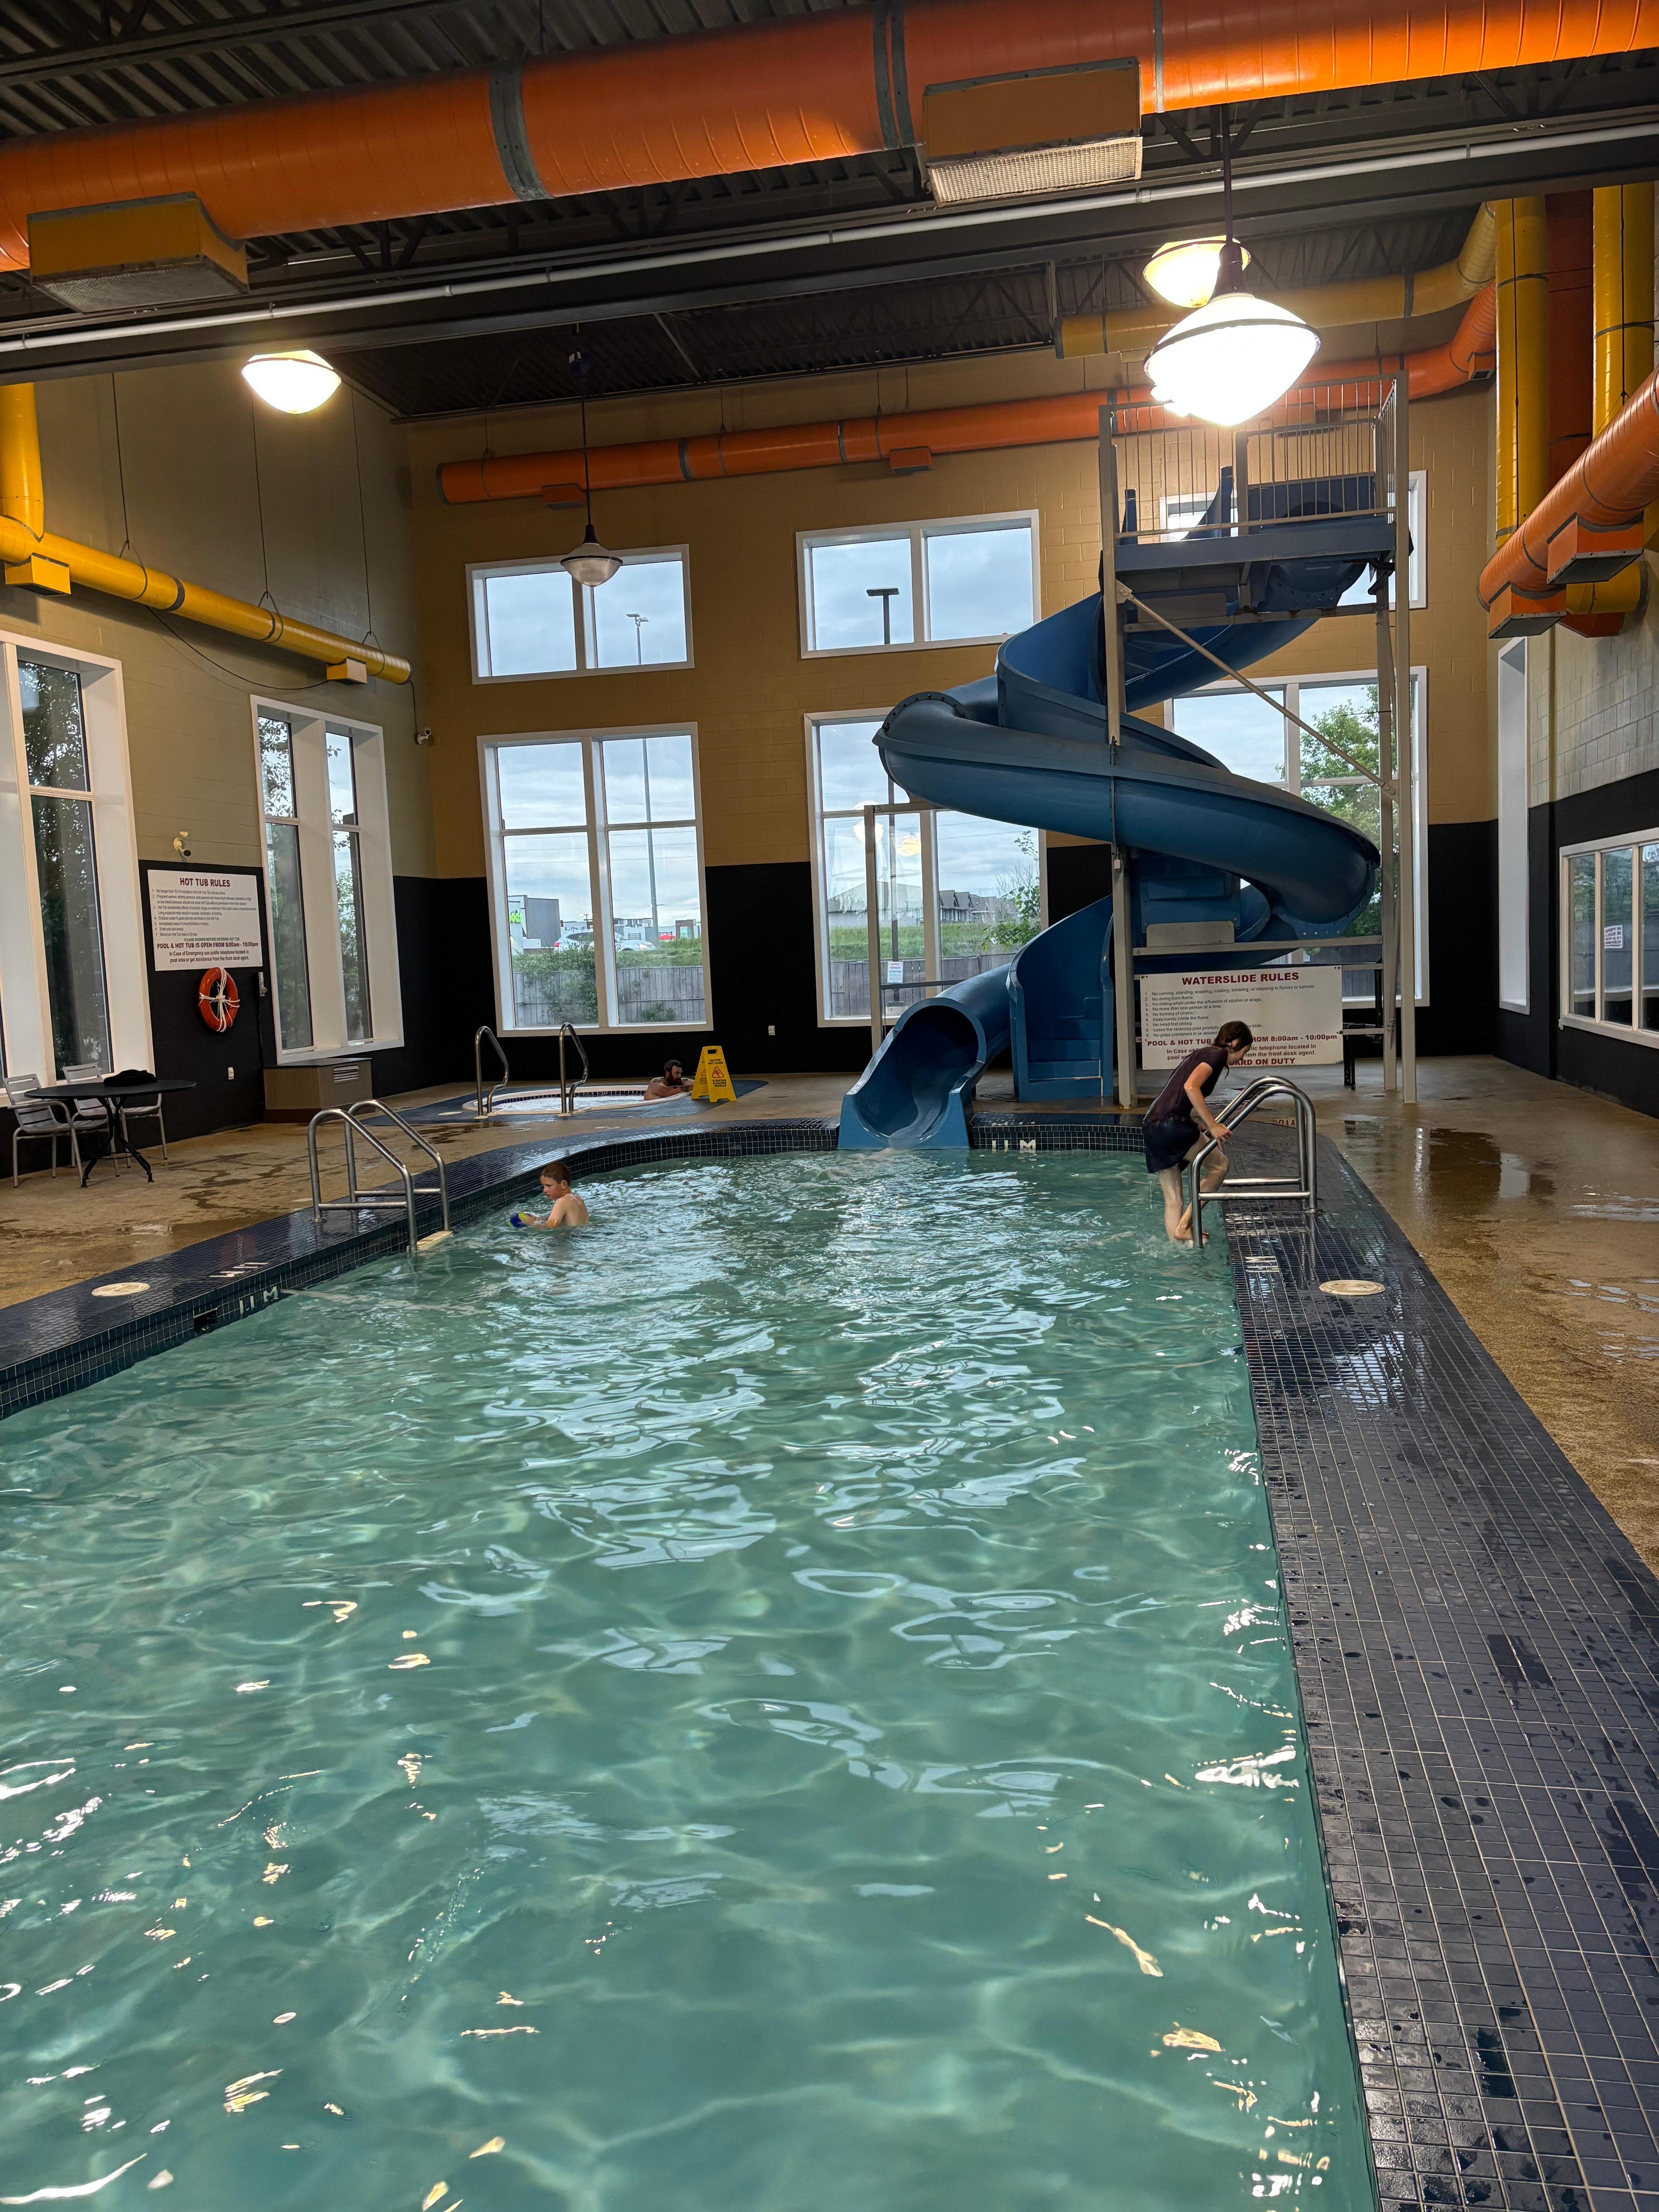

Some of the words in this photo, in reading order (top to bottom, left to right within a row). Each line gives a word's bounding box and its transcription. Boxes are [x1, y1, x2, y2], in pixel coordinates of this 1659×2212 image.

[180, 878, 194, 886] HOT
[1182, 974, 1256, 985] WATERSLIDE
[1261, 972, 1299, 981] RULES
